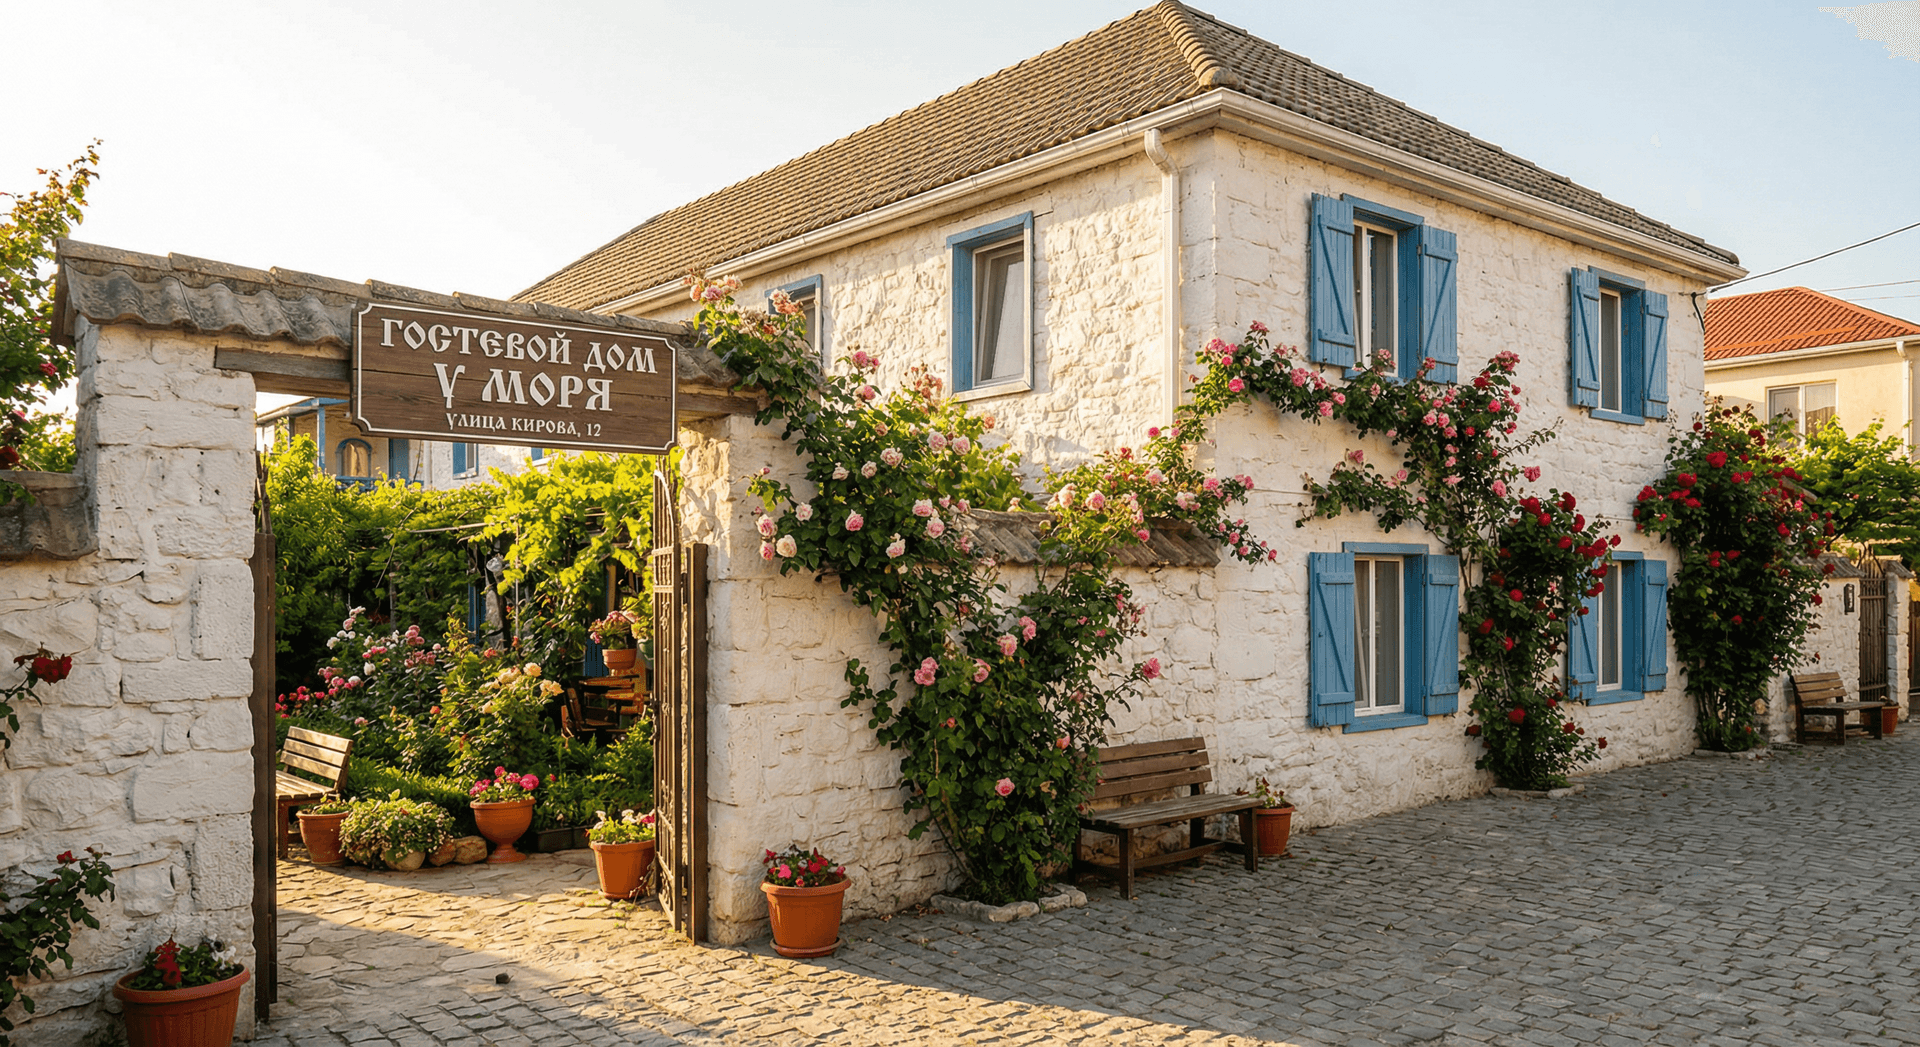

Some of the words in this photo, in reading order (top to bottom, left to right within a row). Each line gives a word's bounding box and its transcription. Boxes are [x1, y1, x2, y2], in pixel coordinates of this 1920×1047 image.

[380, 318, 572, 365] ГОСТЕВОЙ
[583, 341, 658, 374] ДОМ
[433, 362, 466, 409] У
[481, 368, 614, 411] МОРЯ
[446, 412, 507, 432] УЛИЦА
[511, 418, 581, 438] КИРОВА,
[586, 423, 602, 437] 12
